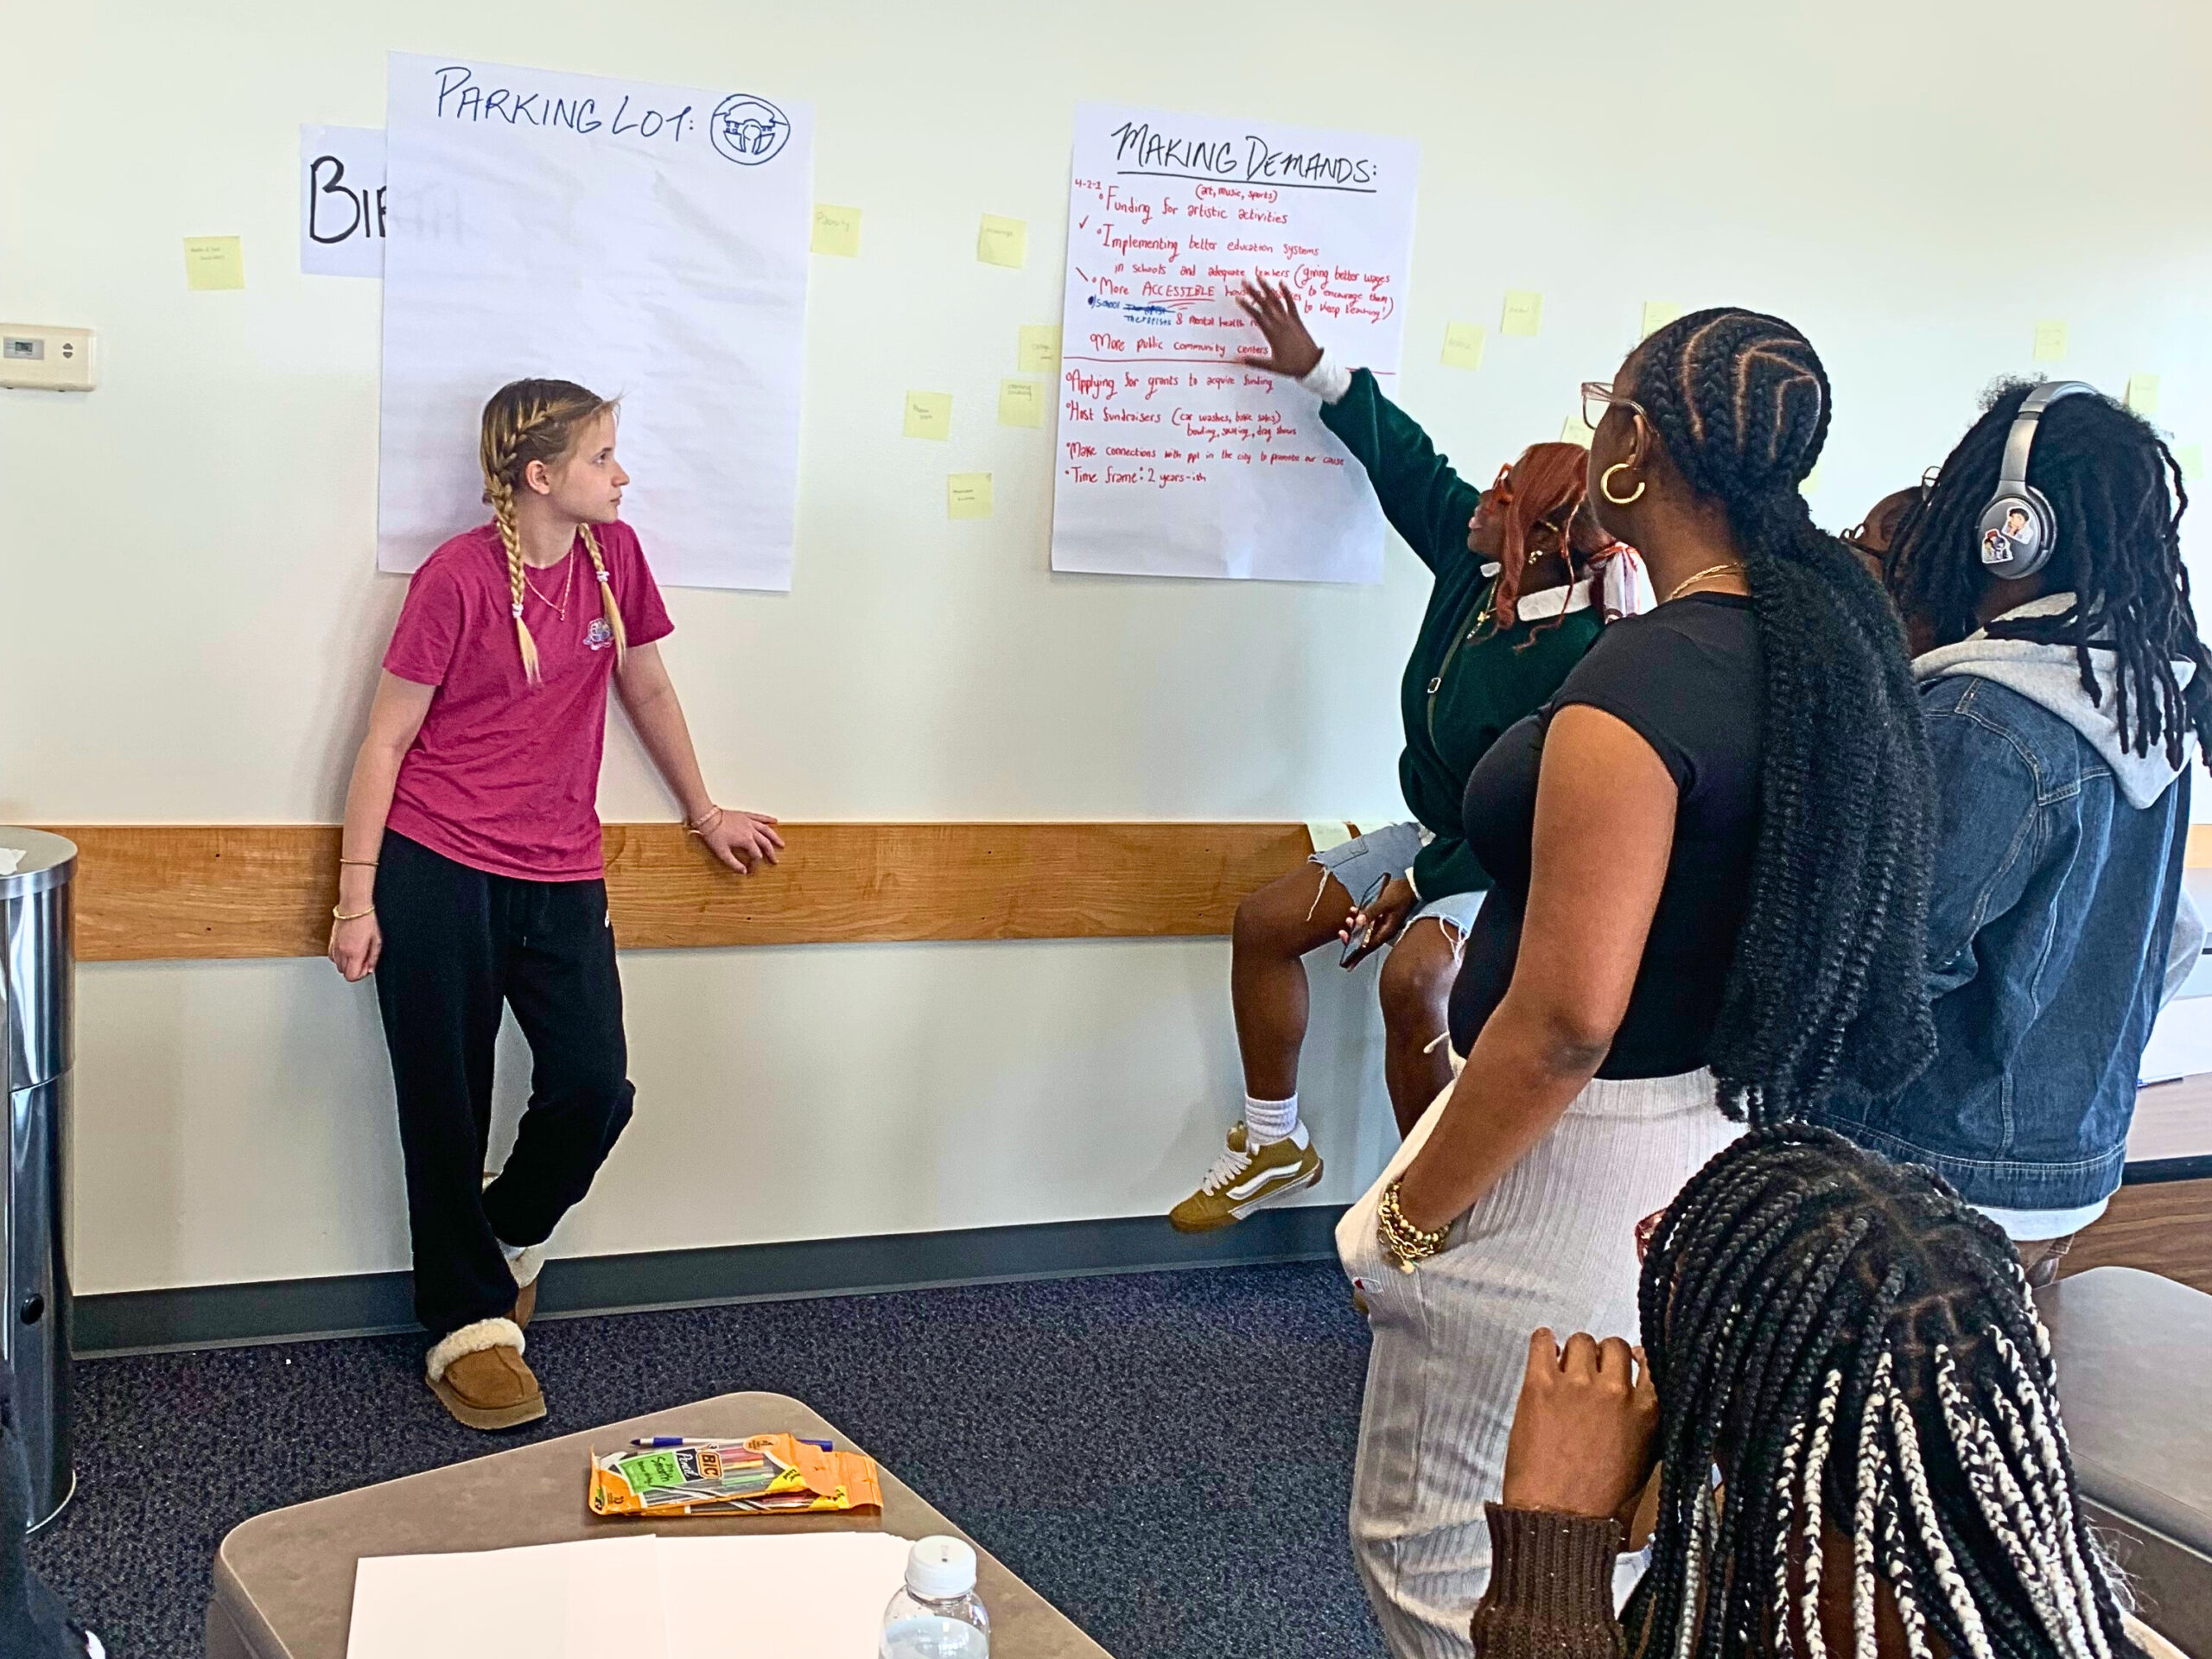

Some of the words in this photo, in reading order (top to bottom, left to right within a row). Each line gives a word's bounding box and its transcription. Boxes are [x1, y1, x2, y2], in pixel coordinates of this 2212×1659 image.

[435, 67, 601, 133] PARKING
[1111, 122, 1237, 174] MAKING
[1245, 136, 1377, 184] DEMANDS:
[1107, 186, 1153, 225] Funding
[1162, 197, 1178, 214] for
[1187, 204, 1228, 219] artistic
[1238, 208, 1288, 224] activities
[1103, 224, 1179, 263] Implementing
[1189, 234, 1217, 251] better
[1227, 238, 1274, 252] education
[1179, 264, 1196, 276] and
[1335, 265, 1359, 281] better
[1100, 276, 1130, 296] More
[1142, 281, 1216, 297] ACCESSIBLE
[1308, 285, 1317, 296] to
[1305, 300, 1313, 314] to
[1094, 334, 1125, 352] More
[1136, 336, 1164, 353] public
[1072, 369, 1118, 400] Applying
[1124, 372, 1139, 387] for
[1145, 375, 1179, 400] grants
[1189, 372, 1198, 386] to
[1243, 374, 1274, 394] funding
[1070, 400, 1094, 421] Host
[1103, 406, 1161, 423] fundraisers
[1070, 442, 1096, 460] Make
[1106, 447, 1156, 458] connections
[1164, 449, 1181, 459] with
[1222, 449, 1232, 459] the
[1071, 466, 1098, 483] Time
[1147, 467, 1156, 482] 2
[701, 1453, 718, 1478] BIC
